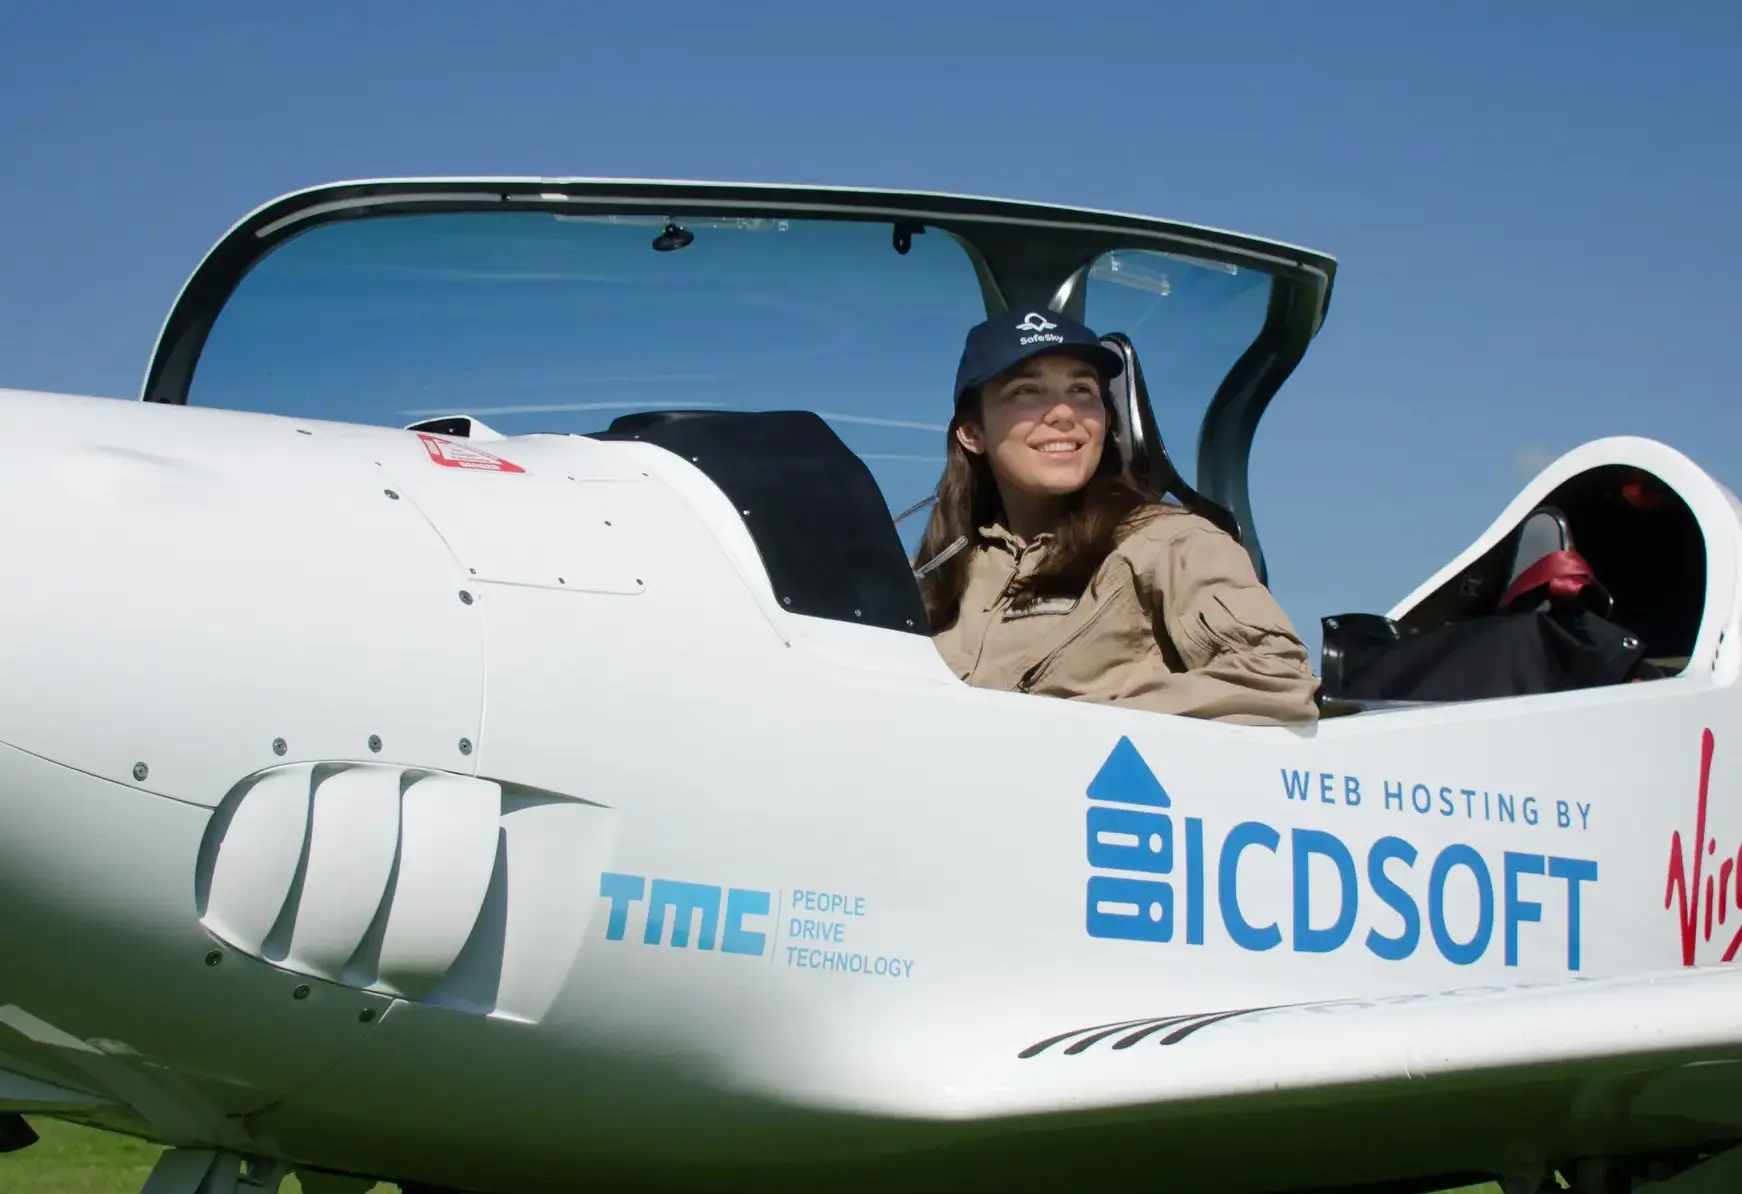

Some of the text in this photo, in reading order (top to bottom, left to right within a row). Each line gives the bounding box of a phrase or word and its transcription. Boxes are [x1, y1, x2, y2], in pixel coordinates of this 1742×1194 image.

[1020, 333, 1064, 345] SafeSky
[1281, 768, 1593, 831] WEB HOSTING BY
[792, 889, 866, 917] PEOPLE
[1185, 817, 1598, 971] ICDSOFT
[600, 872, 771, 956] TMC
[789, 918, 845, 943] DRIVE
[786, 946, 914, 978] TECHNOLOGY
